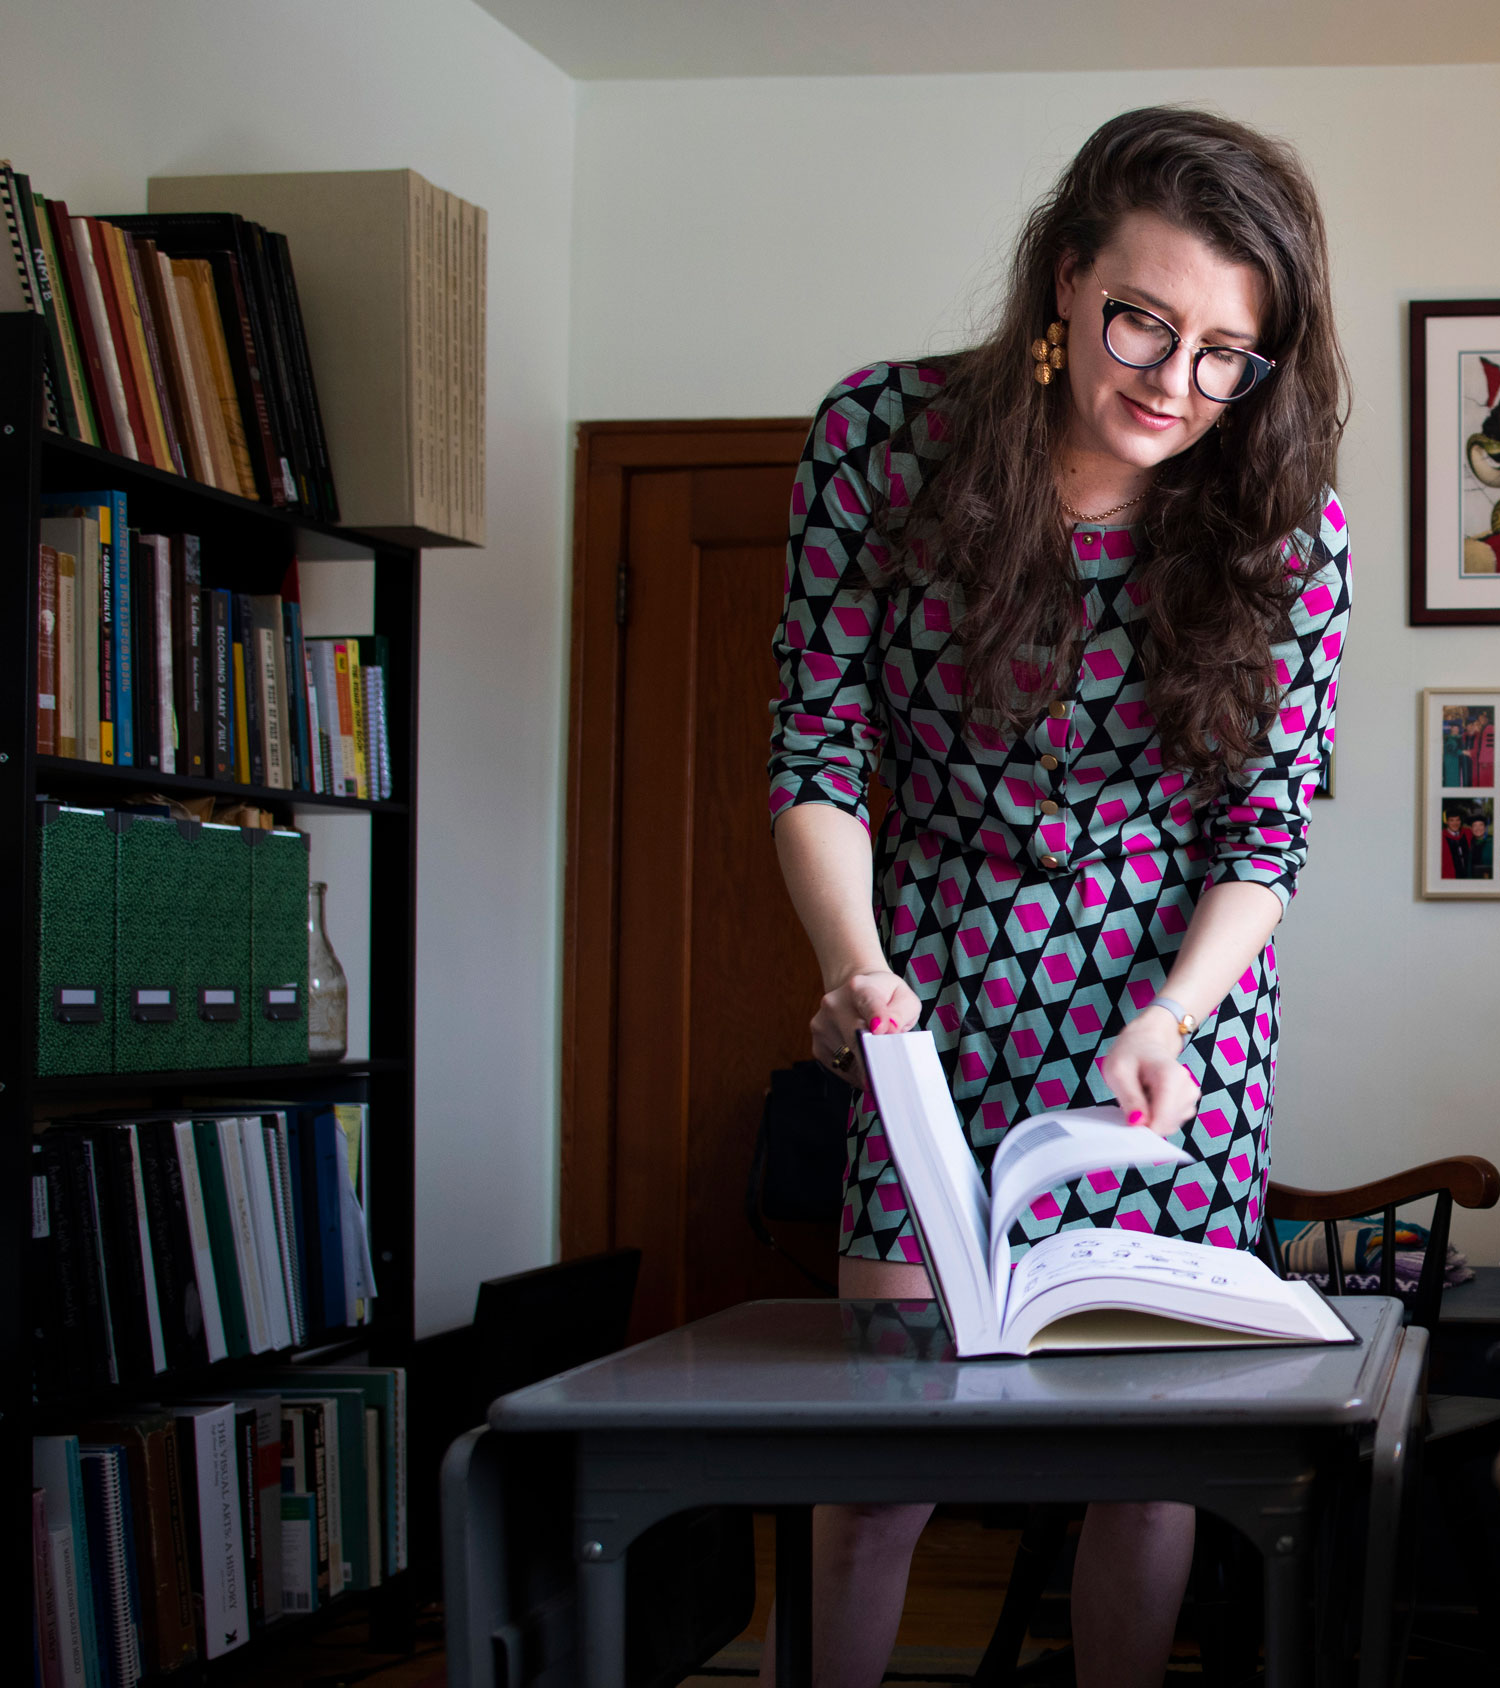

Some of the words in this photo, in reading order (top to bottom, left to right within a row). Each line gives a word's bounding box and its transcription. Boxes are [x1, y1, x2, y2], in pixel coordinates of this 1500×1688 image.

[103, 554, 111, 588] GRANDI
[216, 625, 226, 683] BECOMING
[217, 687, 226, 717] MARY
[217, 719, 227, 753] SULLY
[218, 1419, 226, 1448] THE
[220, 1449, 230, 1501] VISUAL
[224, 1543, 233, 1552] A
[226, 1554, 238, 1609] HISTORY
[72, 1646, 81, 1674] MEXICO
